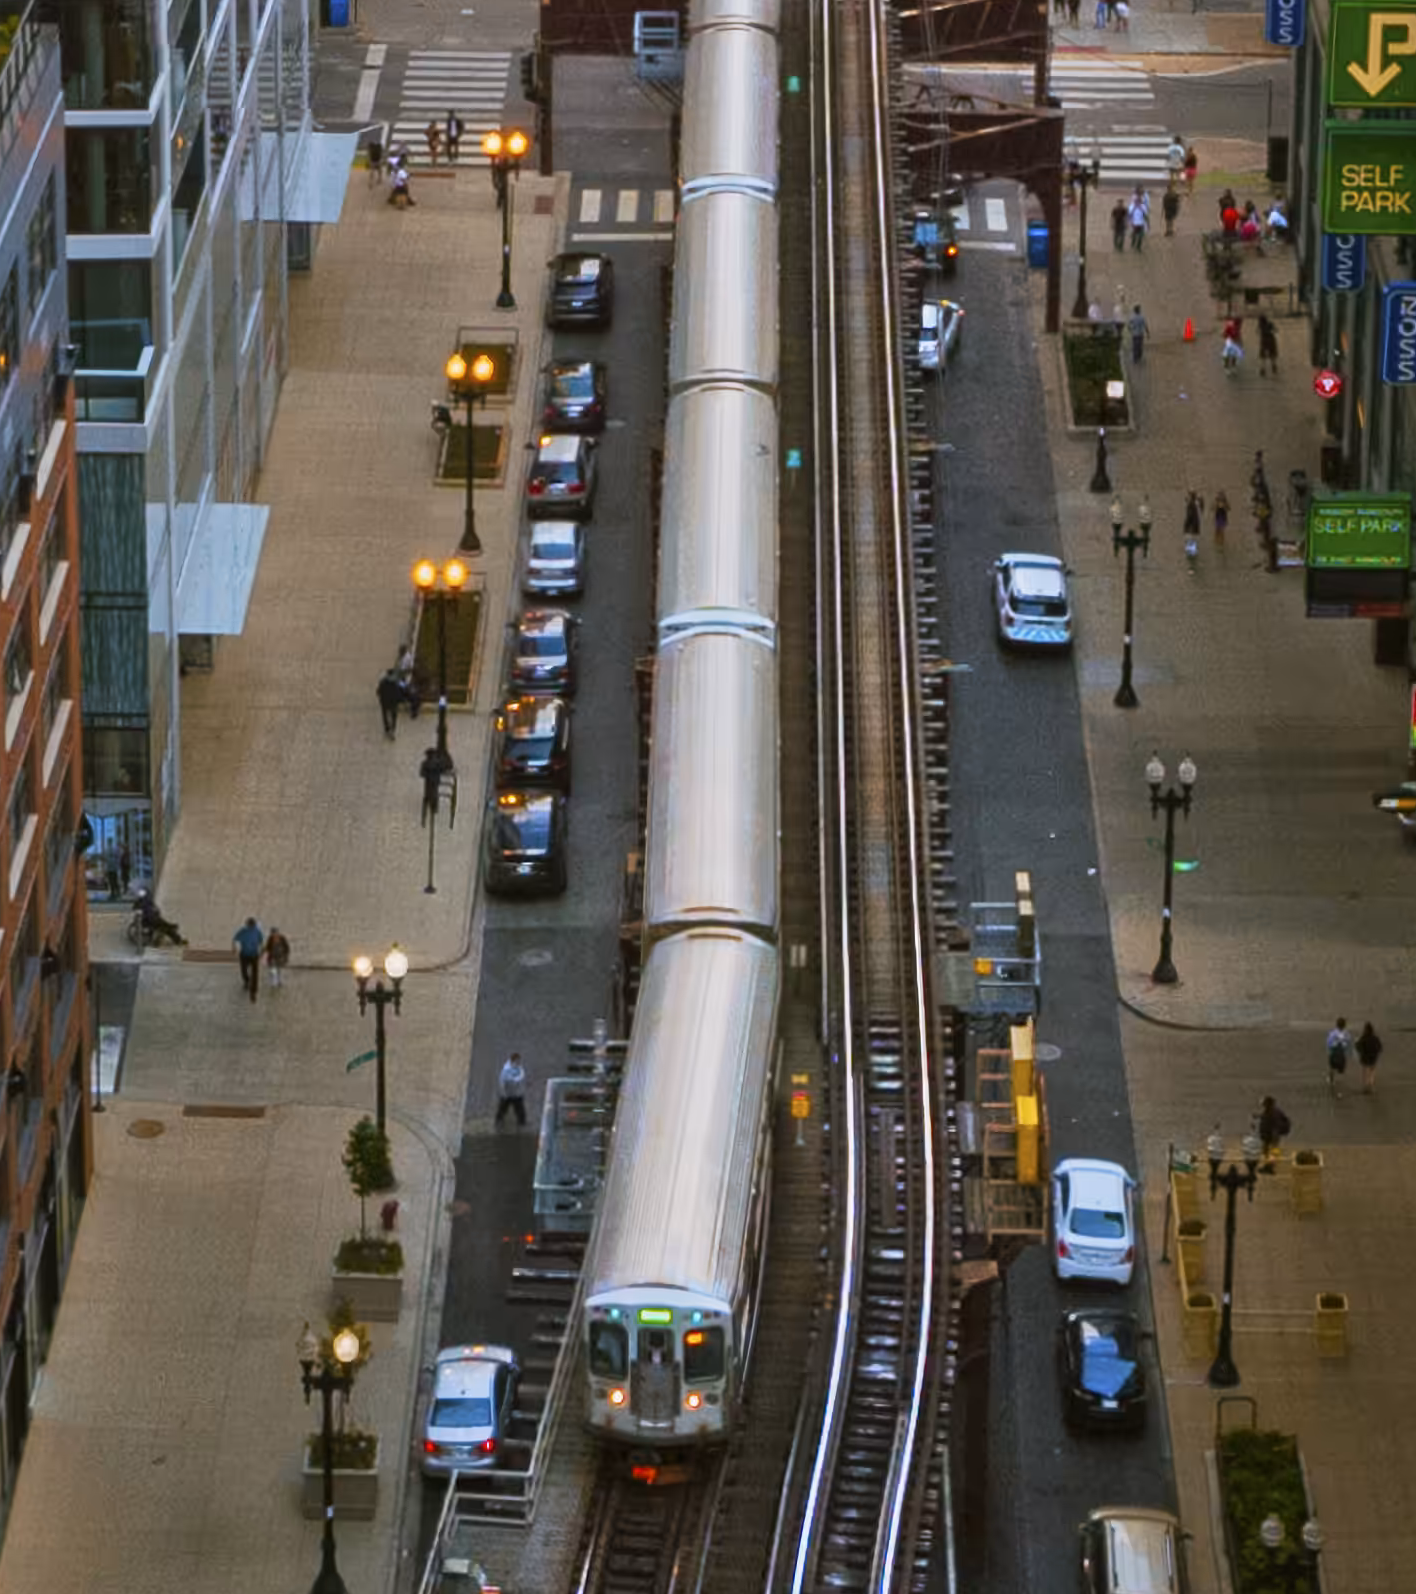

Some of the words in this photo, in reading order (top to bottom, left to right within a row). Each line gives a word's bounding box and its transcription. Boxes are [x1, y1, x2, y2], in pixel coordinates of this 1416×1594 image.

[1341, 164, 1403, 187] SELF
[1340, 190, 1412, 214] PARK
[1335, 235, 1356, 289] OSS
[1314, 517, 1355, 533] SELF
[1360, 517, 1405, 533] PARK
